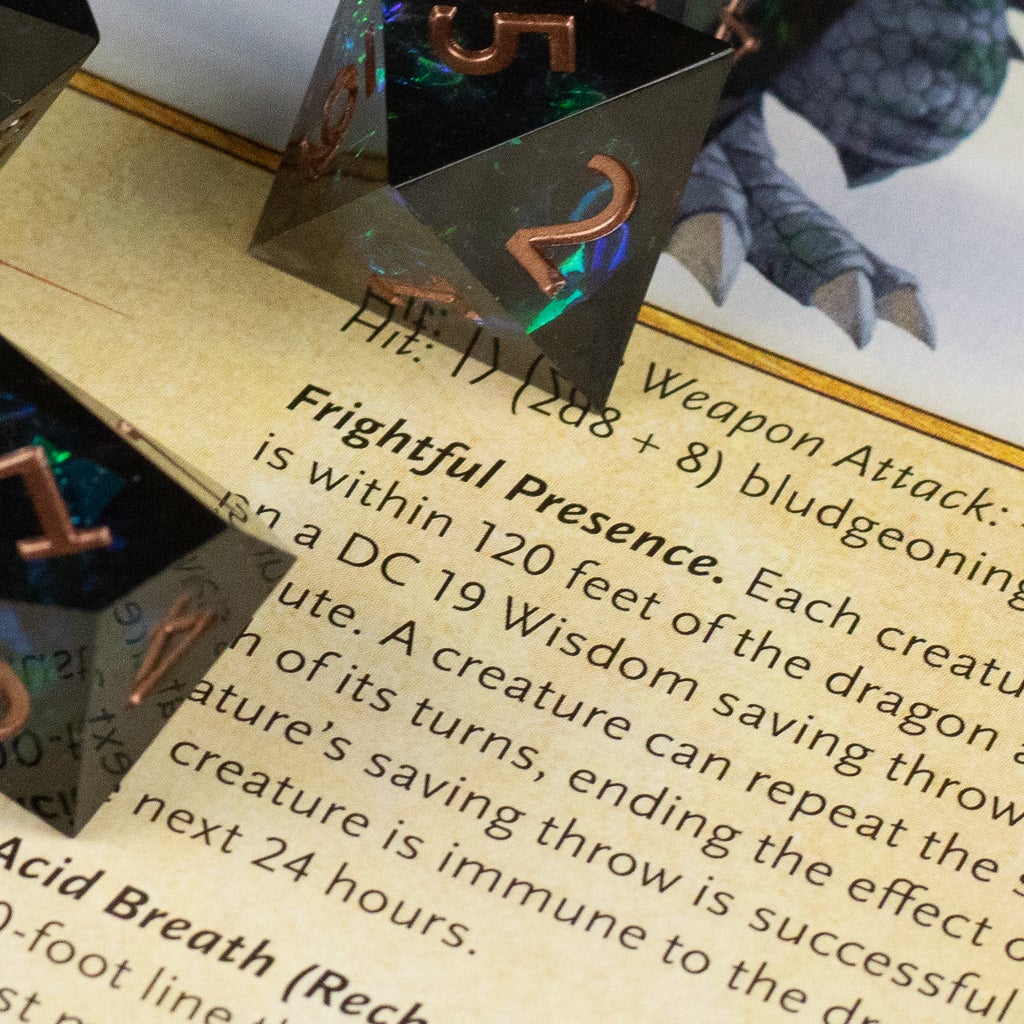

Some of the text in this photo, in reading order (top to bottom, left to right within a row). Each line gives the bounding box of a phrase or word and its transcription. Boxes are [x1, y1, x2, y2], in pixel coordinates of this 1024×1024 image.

[286, 383, 506, 489] Frightful
[504, 474, 724, 584] Presence.
[745, 566, 862, 636] Each
[633, 432, 661, 455] +
[676, 440, 724, 489] 8)
[643, 361, 1009, 527] Weapon Attack:
[252, 432, 1000, 752] is within 120 feet of the dragon
[293, 522, 323, 550] a
[336, 531, 422, 587] DC
[433, 568, 487, 613] 19
[504, 595, 699, 703] Wisdom
[712, 691, 875, 778] saving
[132, 791, 244, 855] next
[251, 835, 317, 884] 24
[324, 861, 476, 956] hours.
[169, 739, 370, 839] creature
[382, 819, 425, 862] is
[437, 841, 647, 951] immune
[661, 934, 712, 976] to
[726, 960, 808, 1014] the
[276, 648, 342, 682] of
[335, 664, 397, 713] its
[410, 697, 546, 783] turns,
[569, 768, 742, 860] ending
[753, 834, 834, 886] the
[847, 877, 993, 947] effect
[378, 619, 416, 657] A
[432, 645, 632, 741] creature
[644, 731, 732, 781] can
[745, 771, 909, 848] repeat
[919, 831, 1000, 883] the
[103, 884, 276, 978] Breath
[141, 966, 233, 1024] line
[363, 751, 527, 842] saving
[535, 817, 684, 894] throw
[692, 875, 736, 916] is
[748, 906, 1019, 1023] successful
